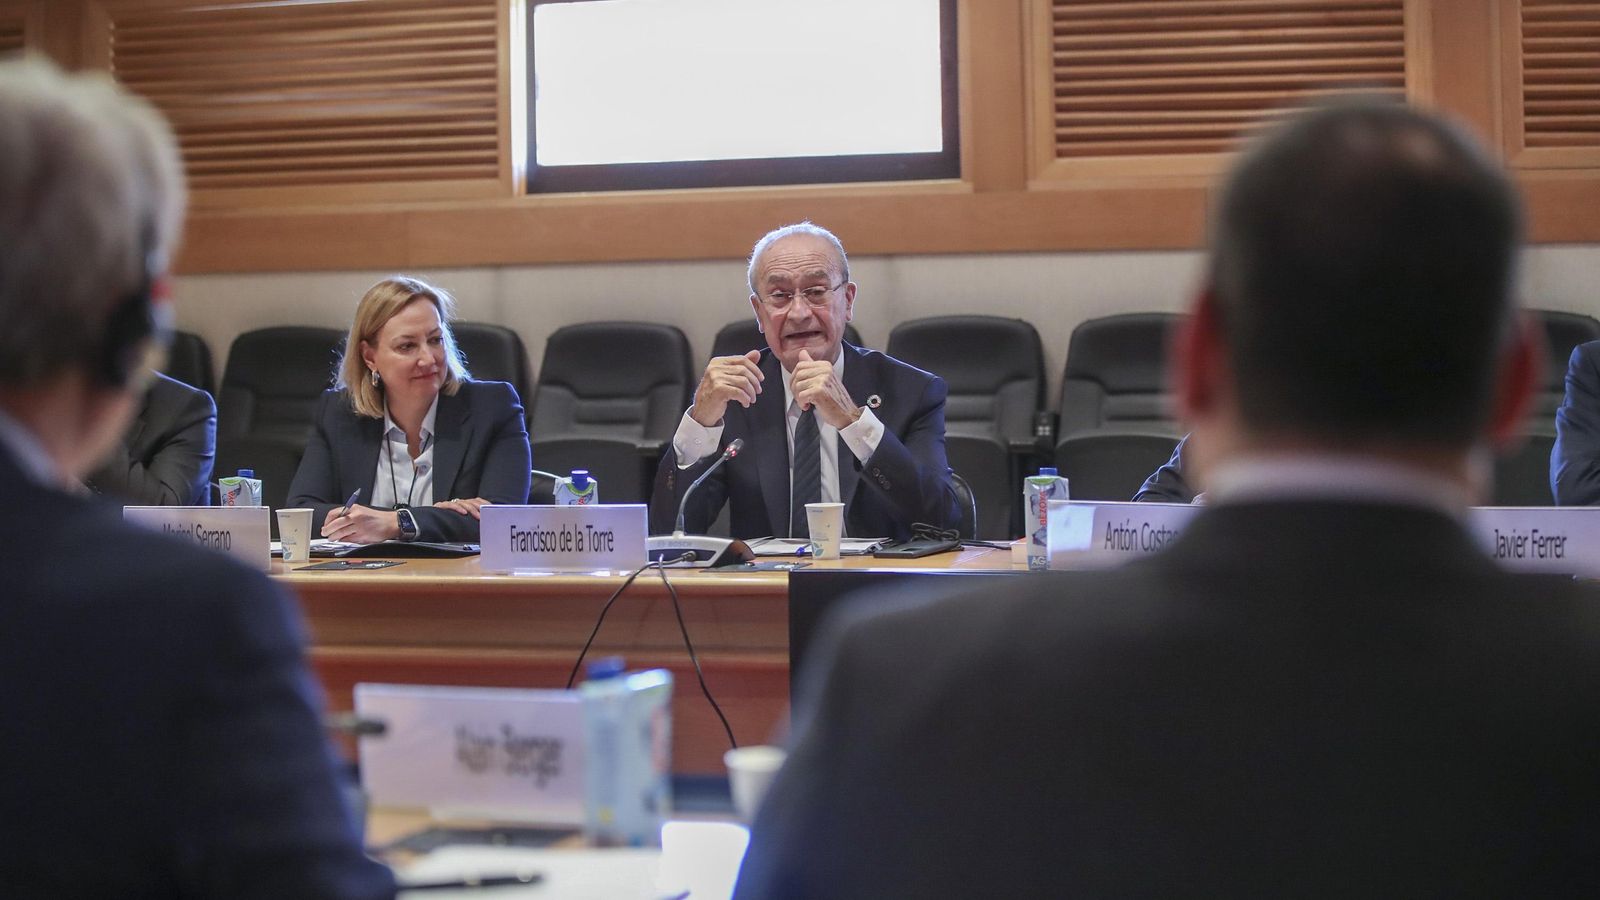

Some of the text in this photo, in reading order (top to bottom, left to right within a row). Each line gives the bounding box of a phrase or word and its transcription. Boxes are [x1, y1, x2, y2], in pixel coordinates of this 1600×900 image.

[196, 523, 231, 551] Serrano
[510, 523, 614, 552] Francisco de la Torre
[1104, 518, 1138, 551] Antón
[1493, 528, 1567, 558] Javier Ferrer
[1031, 556, 1047, 566] AG
